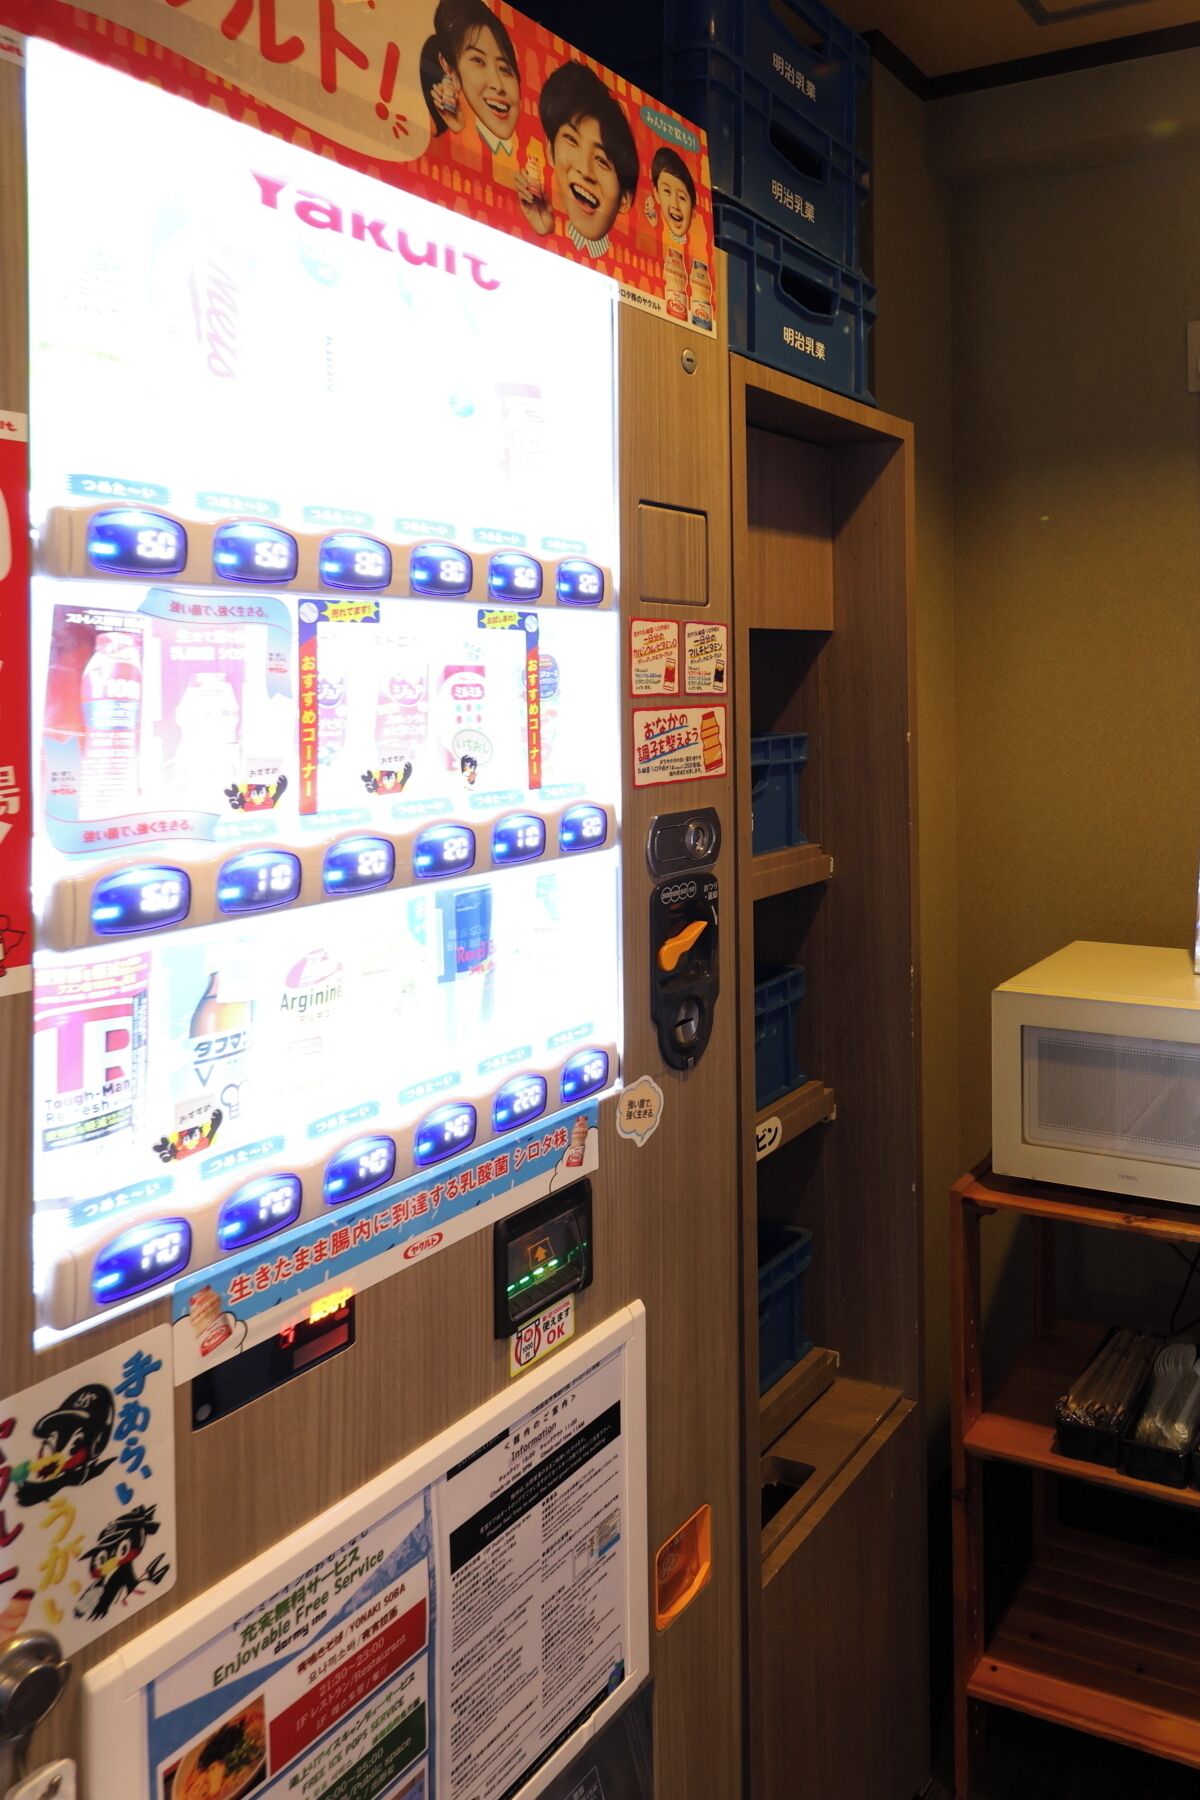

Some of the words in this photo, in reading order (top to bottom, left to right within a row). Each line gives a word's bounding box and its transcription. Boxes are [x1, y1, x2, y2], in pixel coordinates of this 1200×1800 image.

[772, 52, 817, 102] 明治乳業
[771, 179, 816, 224] 明治乳業
[783, 325, 826, 361] 明治乳業
[301, 656, 317, 797] おすすめコーナー
[528, 658, 540, 776] おすすめコーナー
[644, 713, 688, 740] おなかの
[637, 728, 699, 762] 調子を整えよう
[229, 1156, 509, 1304] 生きたまま腸内に到達する乳酸菌
[514, 1129, 568, 1168] シロタ株
[547, 1322, 565, 1344] OK
[383, 1583, 406, 1607] SOBA
[213, 1620, 290, 1687] Enjoyable
[295, 1591, 329, 1625] Free
[334, 1549, 384, 1595] Service
[274, 1625, 309, 1654] dormy
[312, 1609, 327, 1625] inn
